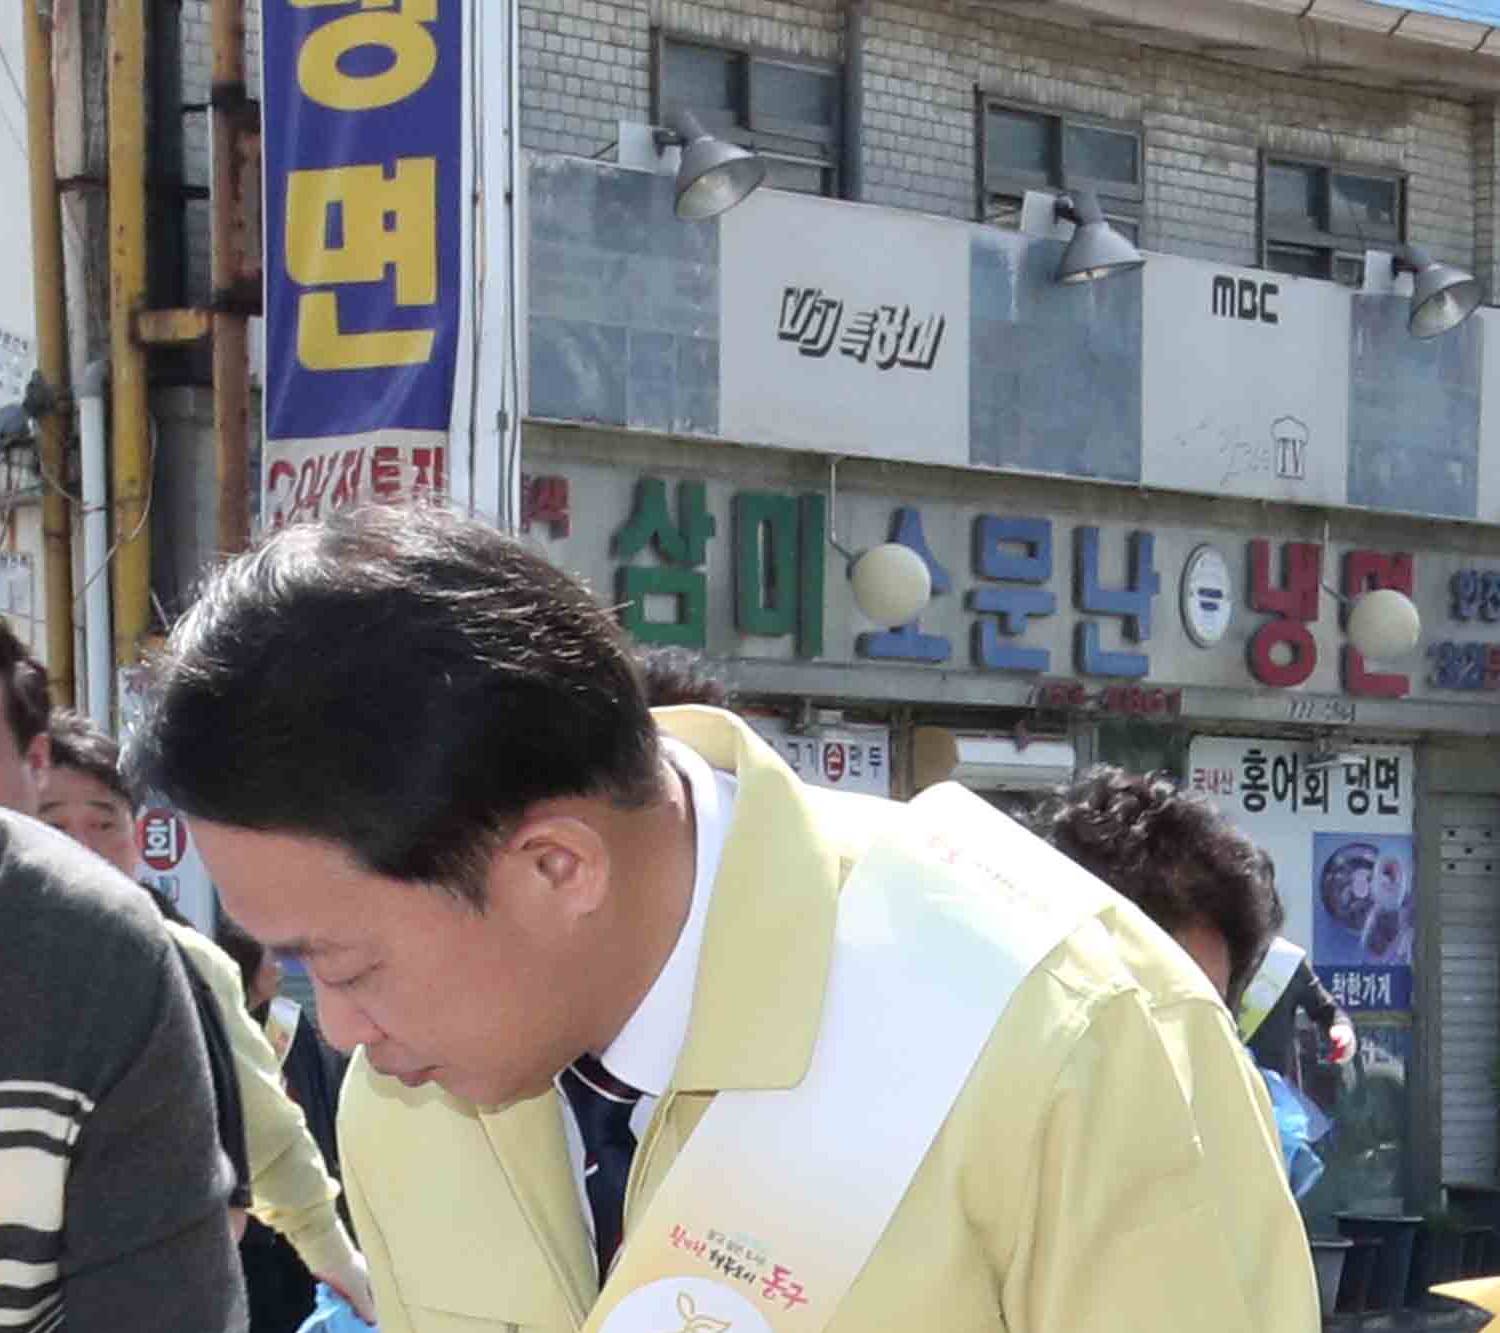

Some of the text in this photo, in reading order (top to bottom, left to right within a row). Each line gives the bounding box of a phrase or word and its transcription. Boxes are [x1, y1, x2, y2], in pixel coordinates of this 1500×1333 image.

[778, 286, 946, 371] VJ 특공대
[1211, 273, 1280, 325] MBC
[611, 475, 826, 658] 삼미
[854, 506, 1160, 677] 소문난
[1240, 749, 1329, 813] 홍어회
[1343, 754, 1399, 816] 냉면
[144, 818, 177, 863] 회
[761, 1264, 809, 1311] 동구
